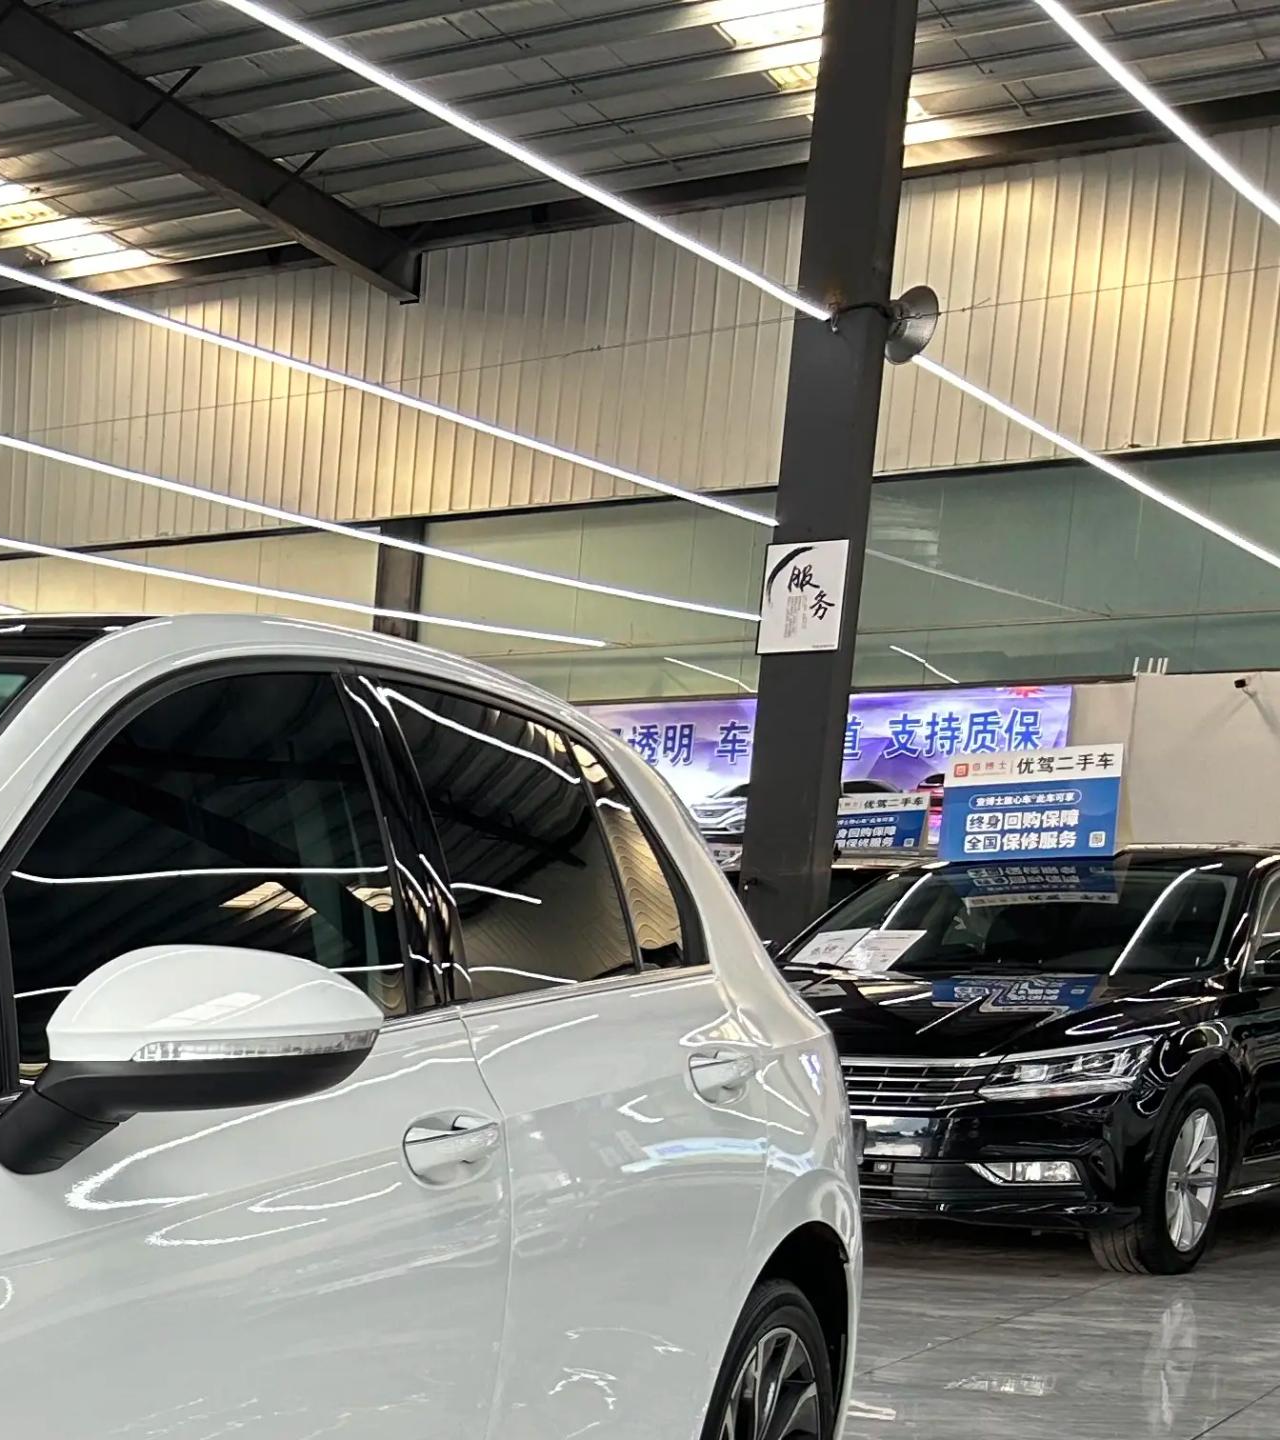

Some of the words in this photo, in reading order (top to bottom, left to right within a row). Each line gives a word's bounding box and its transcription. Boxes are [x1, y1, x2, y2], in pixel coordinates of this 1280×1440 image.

[787, 565, 835, 620] 服务
[608, 724, 694, 765] 透明
[885, 709, 1042, 756] 支持质保
[1016, 751, 1114, 775] 优驾二手车
[968, 809, 1081, 831] 终身回购保障
[966, 831, 1077, 853] 全国保修服务
